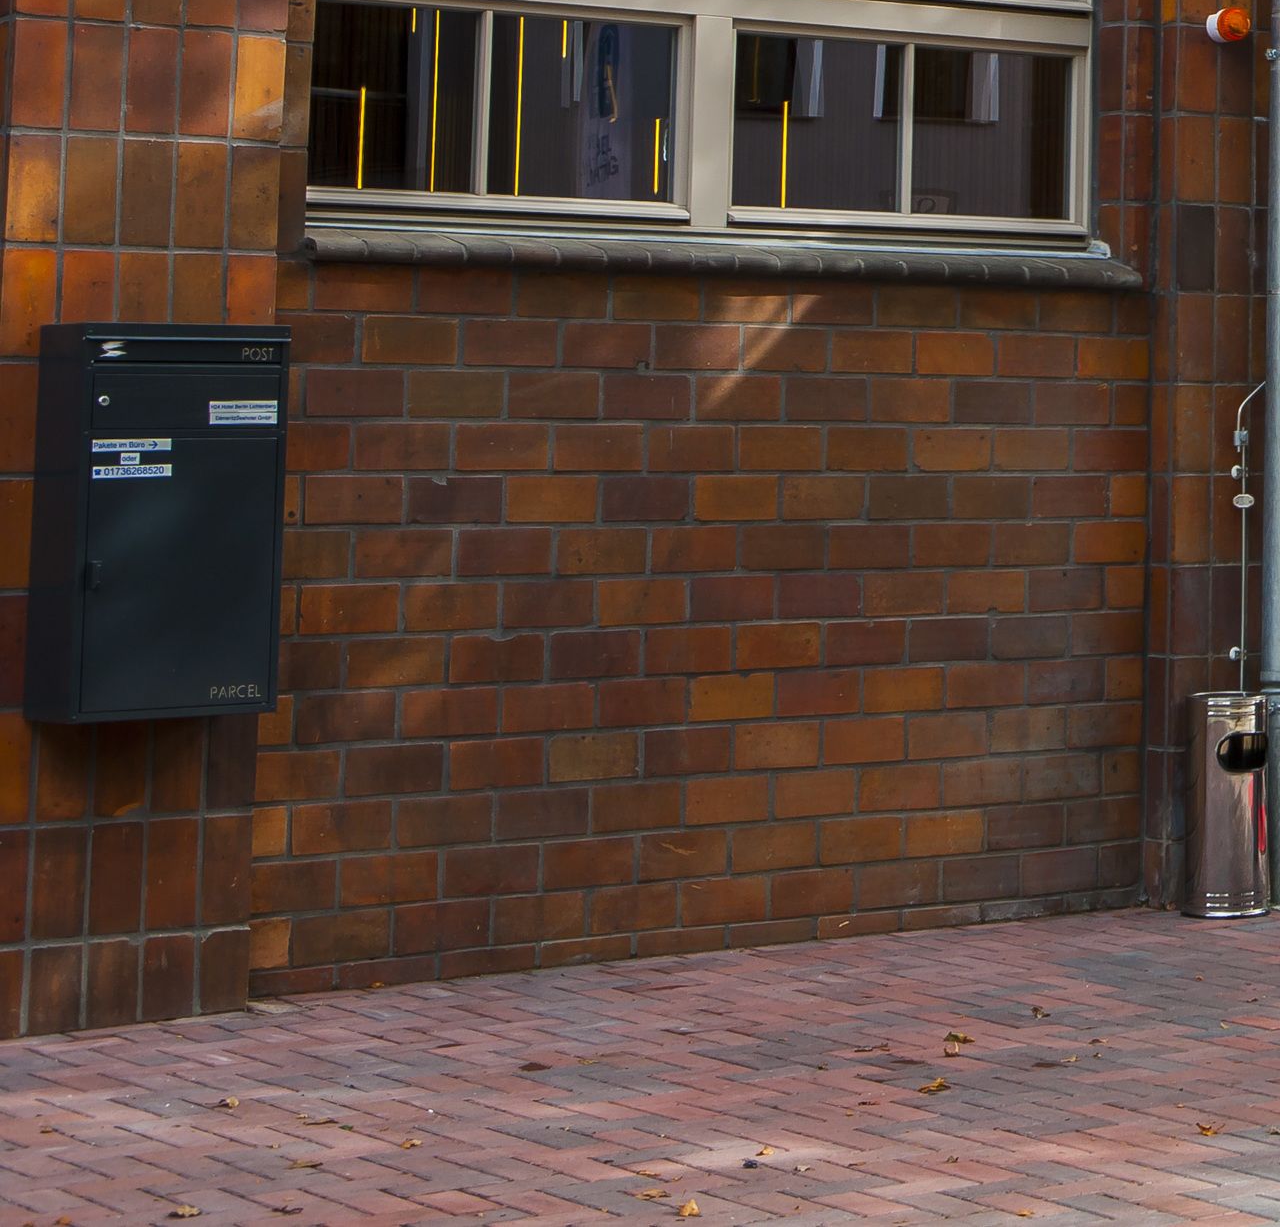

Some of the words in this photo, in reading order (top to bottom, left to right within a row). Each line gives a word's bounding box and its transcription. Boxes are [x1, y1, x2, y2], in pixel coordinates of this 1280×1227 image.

[241, 347, 275, 361] POST
[94, 441, 117, 449] Pakete
[129, 441, 145, 449] Büro
[210, 684, 262, 699] PARCEL
